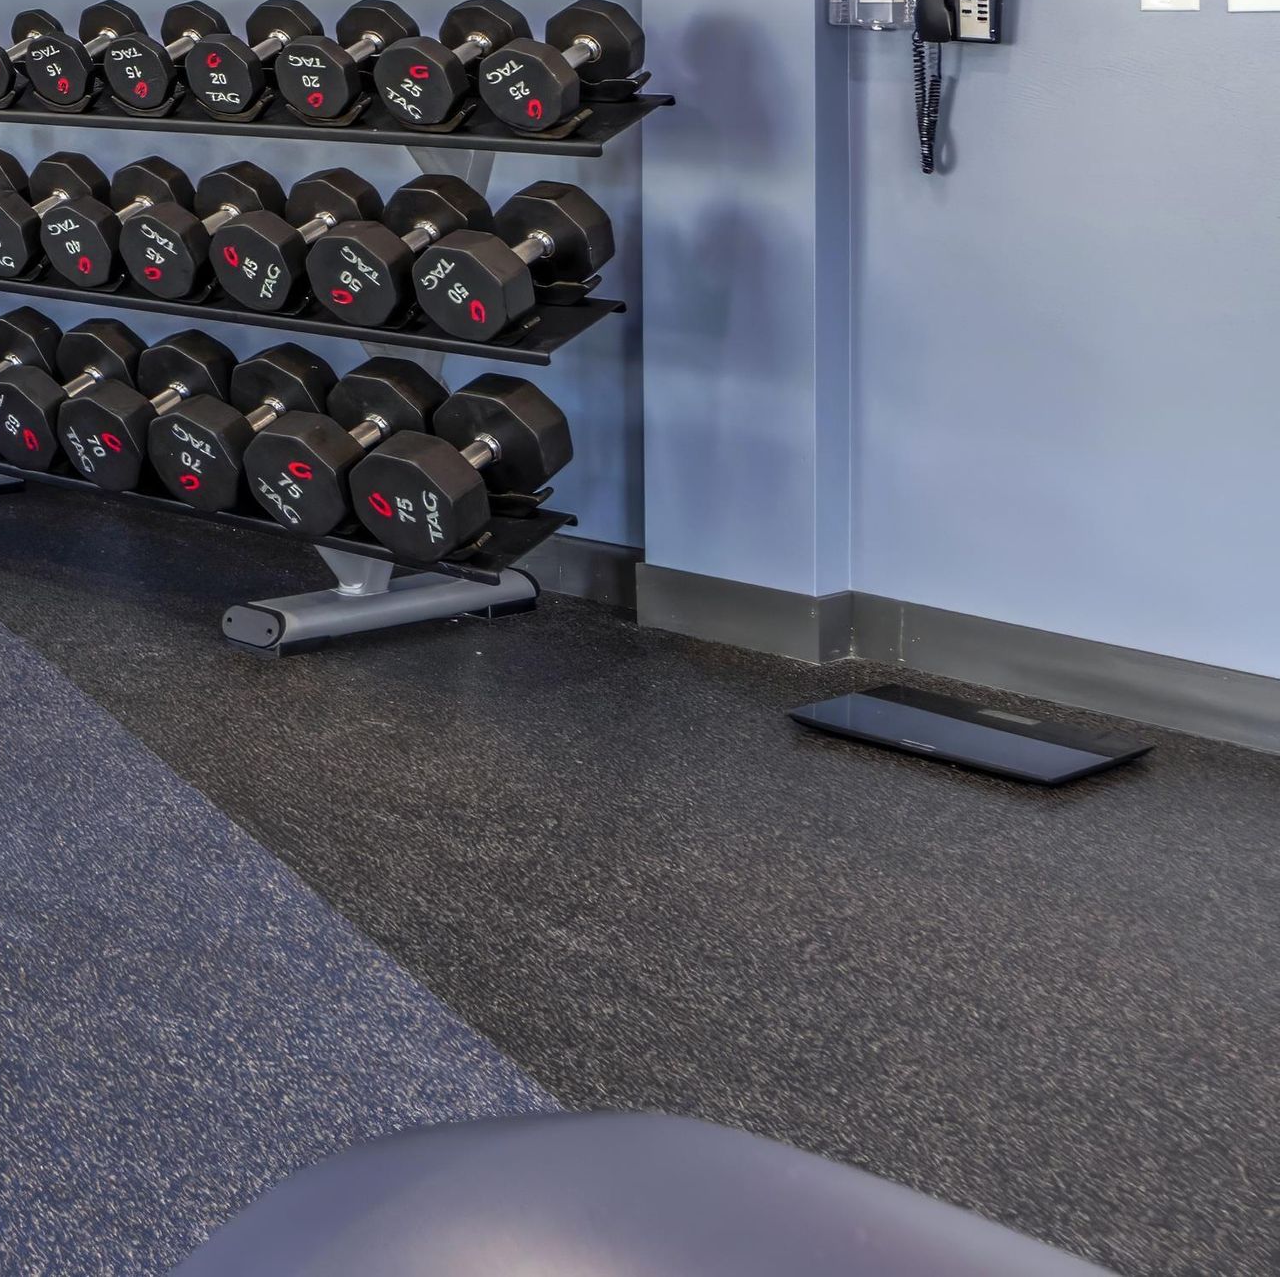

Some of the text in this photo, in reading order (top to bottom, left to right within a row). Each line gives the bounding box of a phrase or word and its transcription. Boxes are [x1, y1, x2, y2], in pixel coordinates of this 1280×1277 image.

[31, 45, 60, 61] TAG
[111, 46, 143, 61] TAG
[288, 55, 327, 68] TAG
[46, 63, 62, 77] 15
[125, 65, 142, 79] 15
[209, 73, 227, 85] 20
[302, 75, 320, 87] 20
[486, 60, 524, 85] TAG
[205, 91, 240, 105] TAG
[400, 78, 423, 98] 25
[509, 81, 531, 101] 25
[385, 86, 423, 120] TAG
[49, 219, 80, 236] TAG
[65, 240, 81, 255] 40
[140, 223, 178, 256] TAG
[145, 247, 165, 265] 45
[340, 245, 382, 286] TAG
[241, 257, 259, 280] 45
[421, 258, 456, 290] TAG
[260, 263, 282, 299] TAG
[339, 270, 364, 293] 50
[448, 282, 470, 305] 50
[5, 415, 20, 435] 65
[66, 426, 96, 473] TAG
[86, 435, 105, 457] 70
[172, 423, 216, 459] TAG
[181, 452, 203, 473] 70
[277, 472, 304, 498] 75
[257, 477, 301, 524] TAG
[396, 497, 416, 522] 75
[422, 490, 443, 542] TAG
